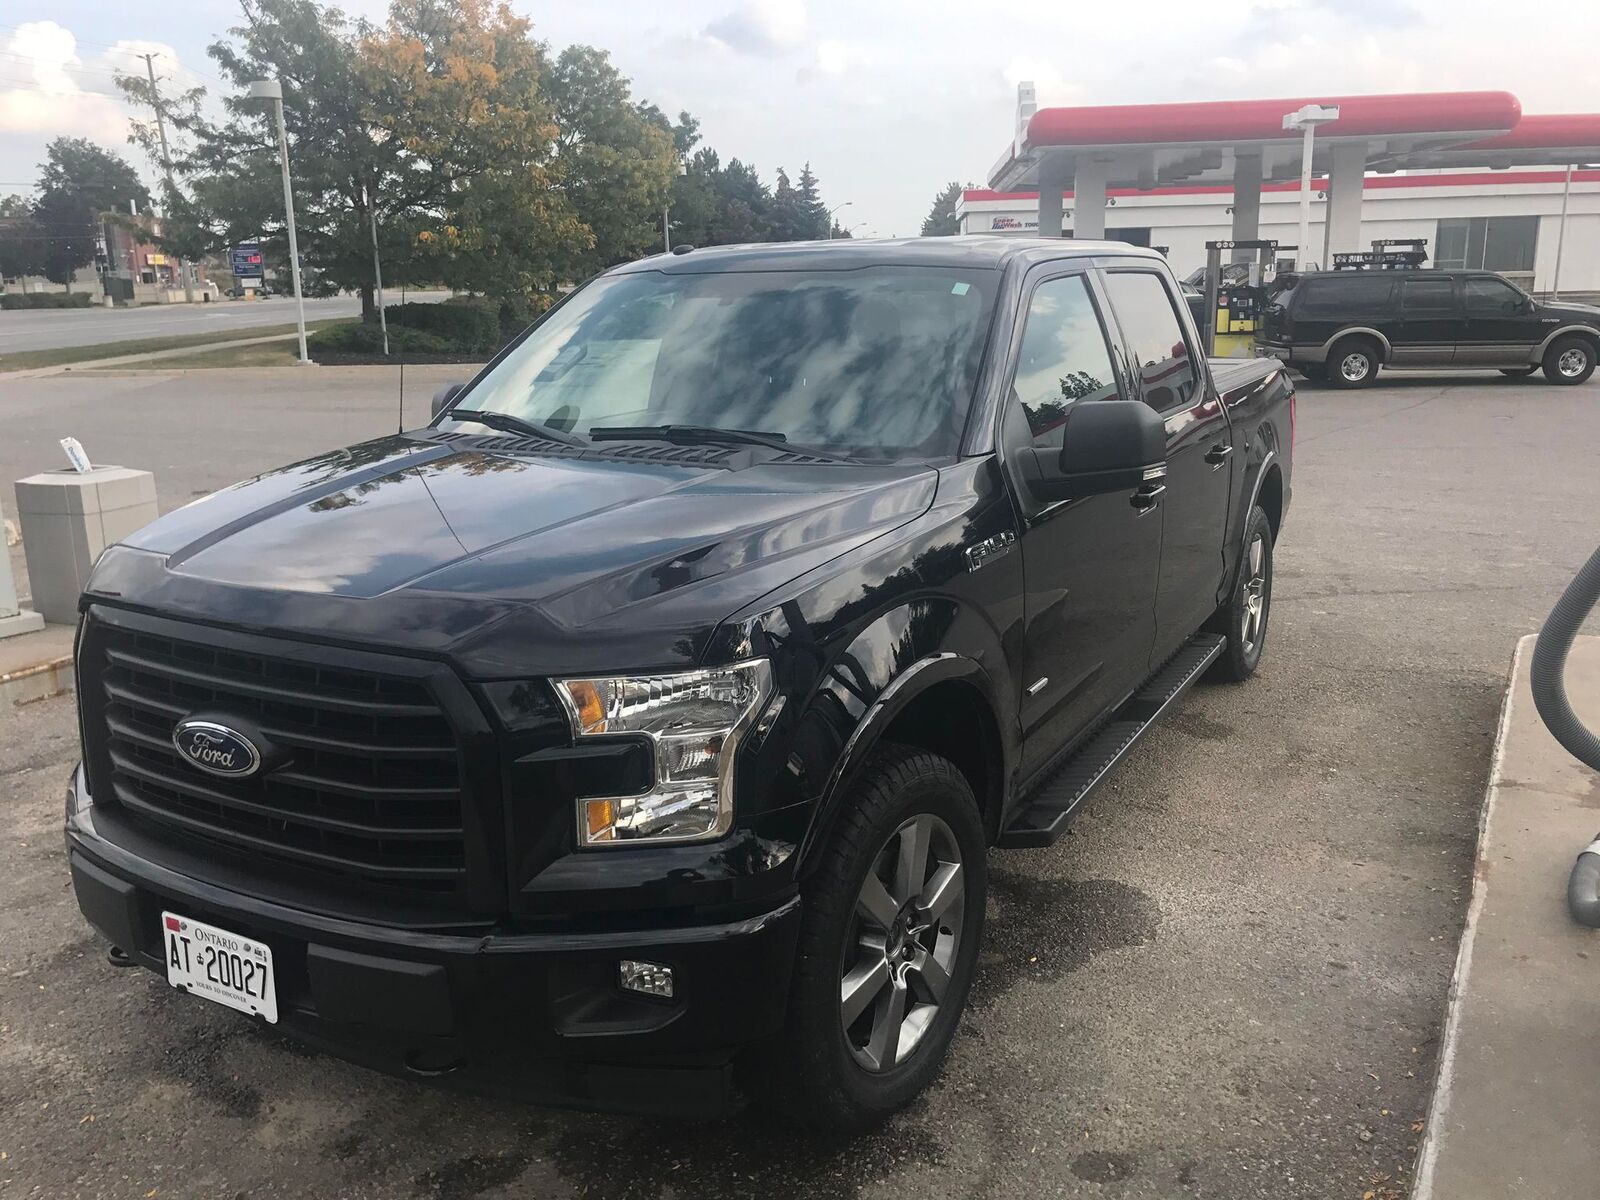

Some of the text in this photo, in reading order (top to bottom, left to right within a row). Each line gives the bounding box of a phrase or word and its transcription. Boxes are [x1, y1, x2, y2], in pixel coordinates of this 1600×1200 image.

[189, 732, 235, 767] Ford
[194, 927, 238, 951] ONTARIO
[170, 933, 267, 1000] AT 20027
[195, 980, 247, 1003] YOURS TO DISCOVER
